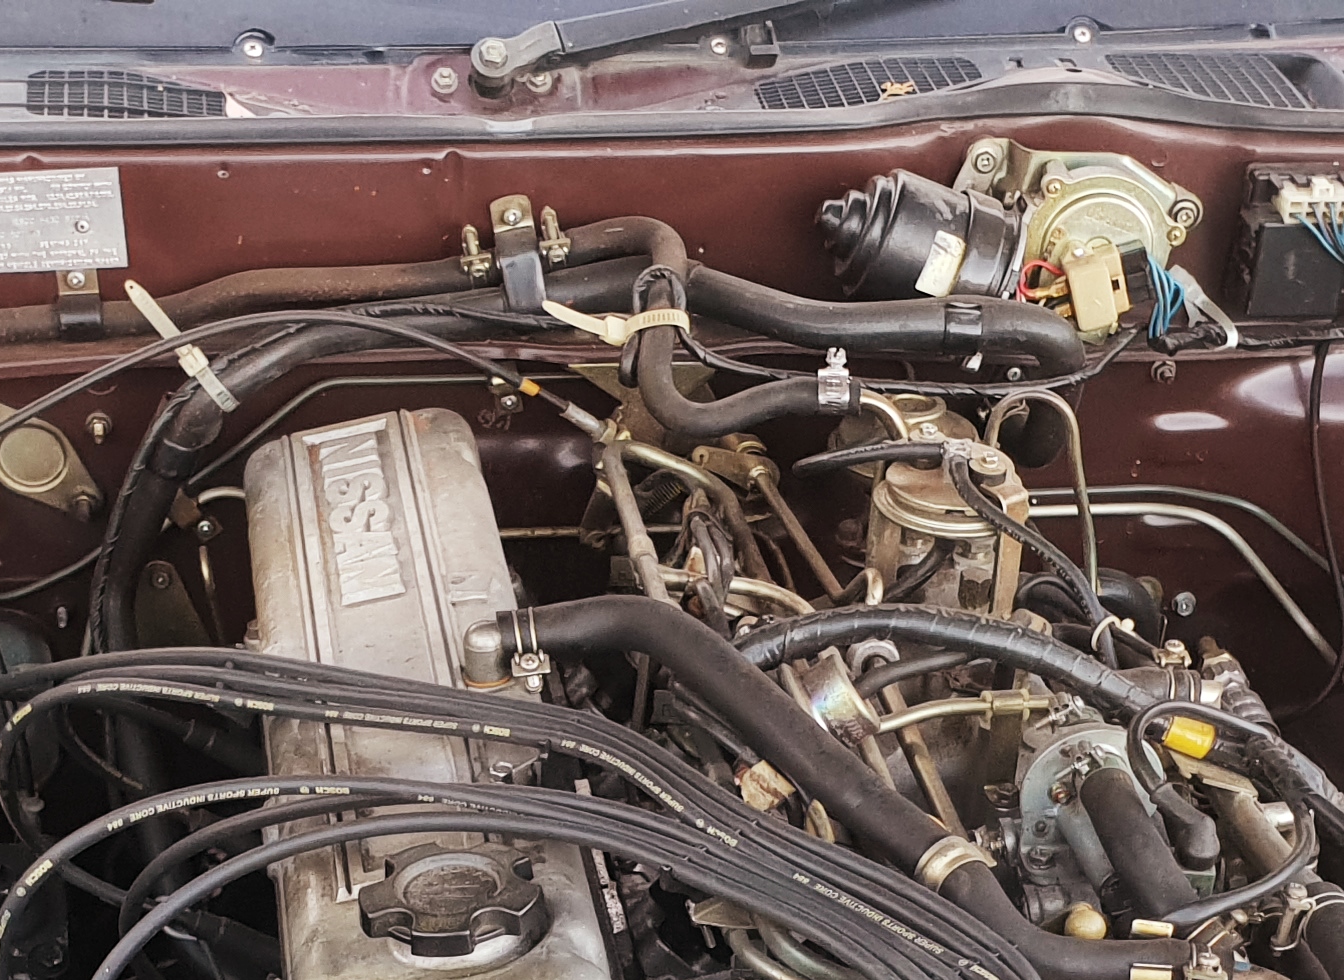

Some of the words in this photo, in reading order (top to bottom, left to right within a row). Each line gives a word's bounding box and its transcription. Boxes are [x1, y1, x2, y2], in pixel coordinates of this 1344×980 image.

[302, 418, 406, 606] NISSAN
[207, 789, 246, 803] SPORTS
[248, 786, 280, 797] SUPER
[314, 786, 350, 795] BOSCH
[156, 794, 206, 813] INDUCTIVE
[129, 807, 155, 823] CORE
[813, 883, 838, 900] CORE
[838, 895, 883, 924] INDUCTIVE
[882, 919, 916, 941] SPORTS
[913, 936, 944, 955] SUPER
